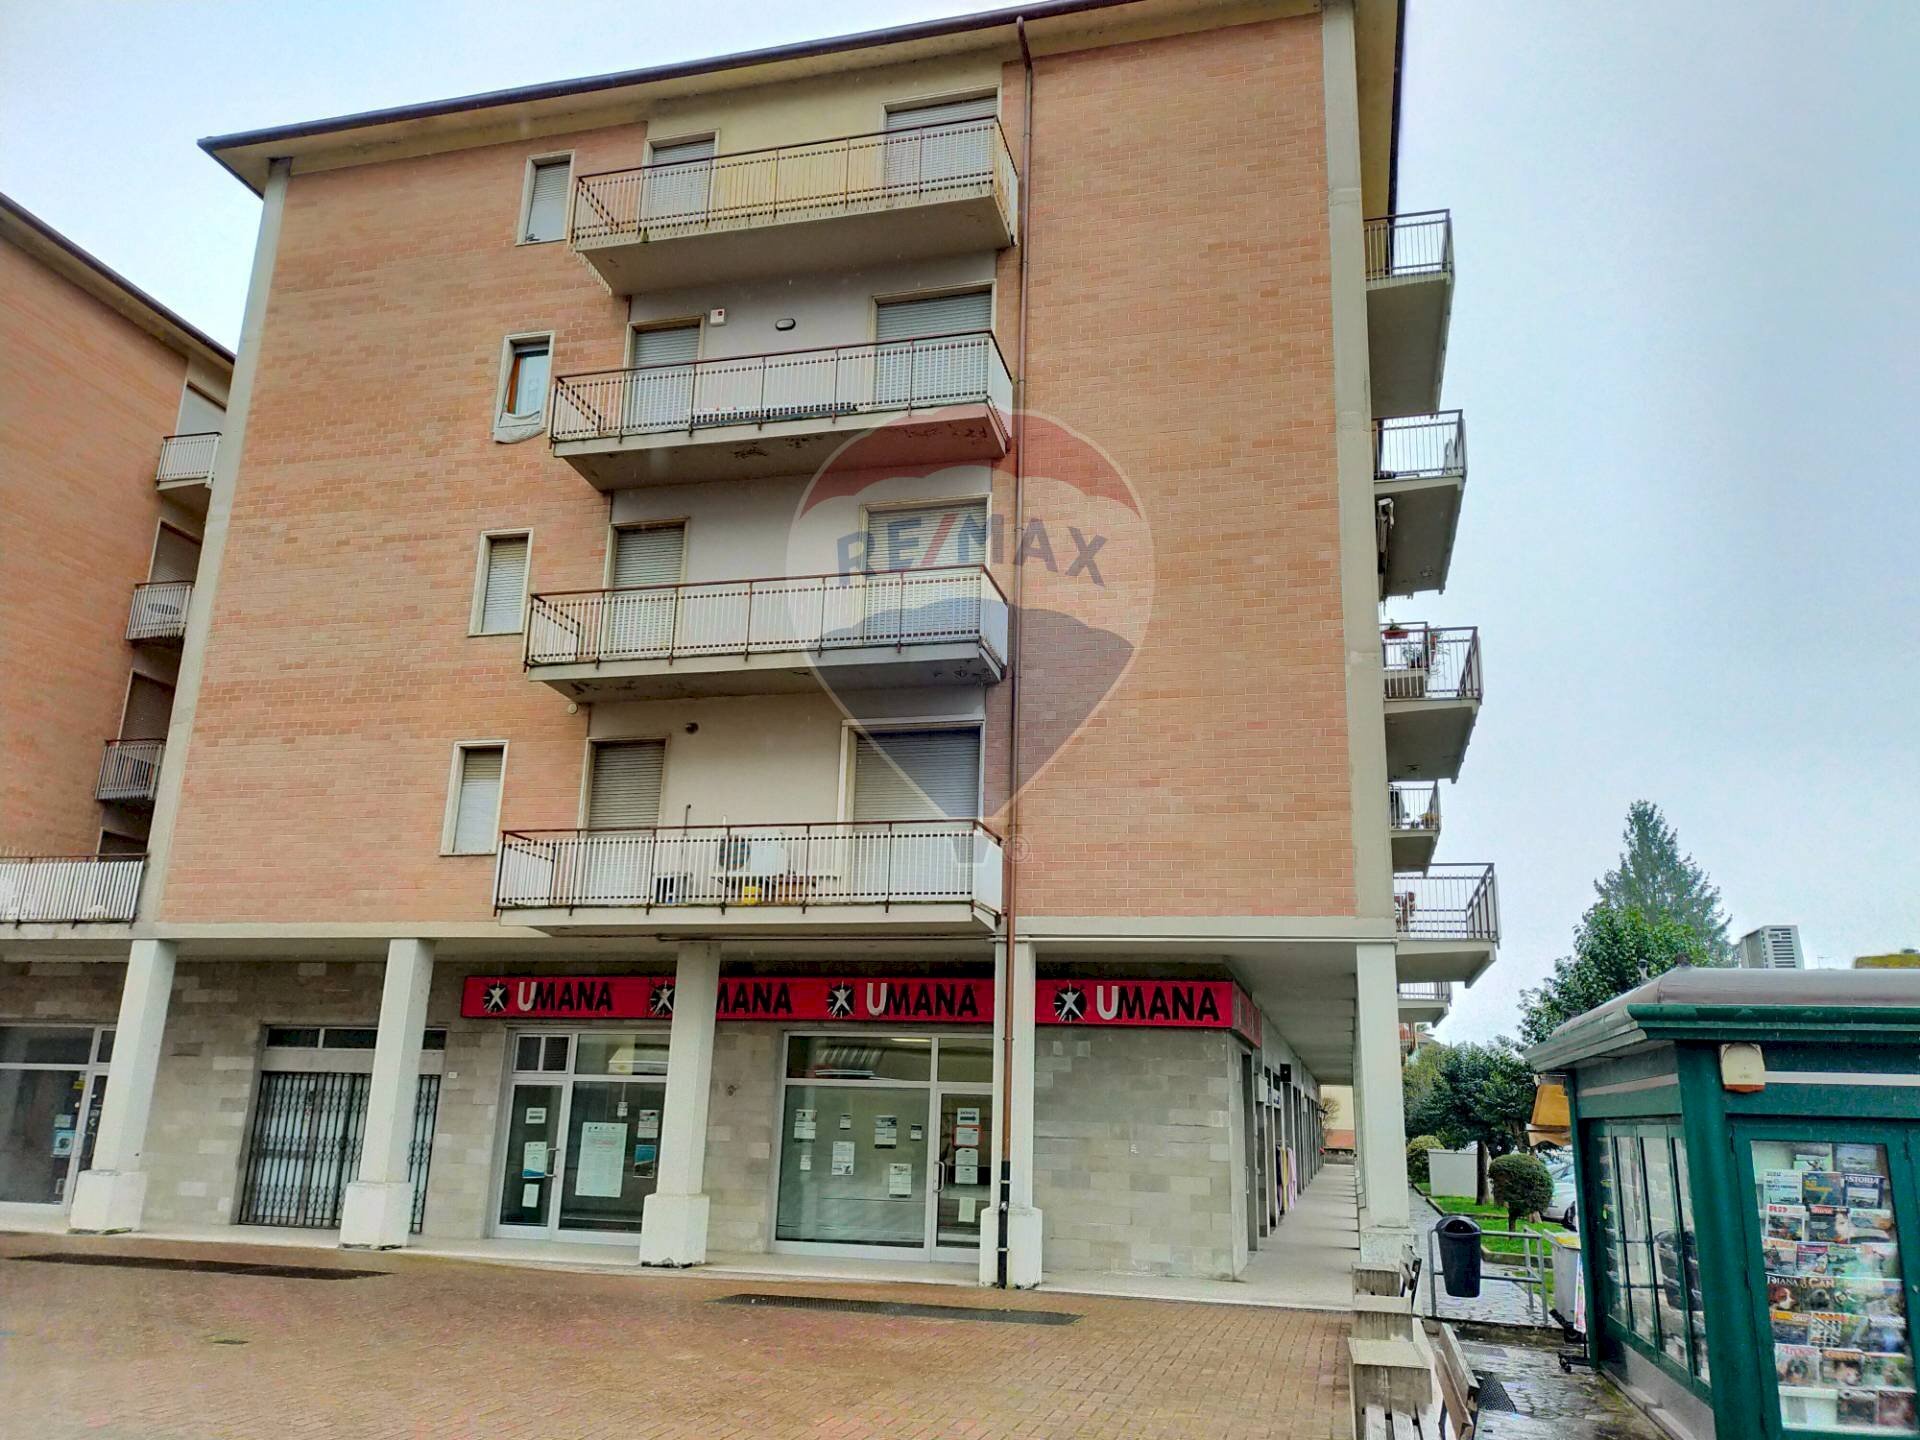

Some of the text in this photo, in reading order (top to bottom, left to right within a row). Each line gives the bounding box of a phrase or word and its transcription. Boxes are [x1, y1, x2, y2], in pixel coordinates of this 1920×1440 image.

[517, 981, 614, 1012] UMANA
[715, 982, 793, 1014] MANA
[866, 982, 979, 1017] UMANA
[1096, 985, 1220, 1021] UMANA
